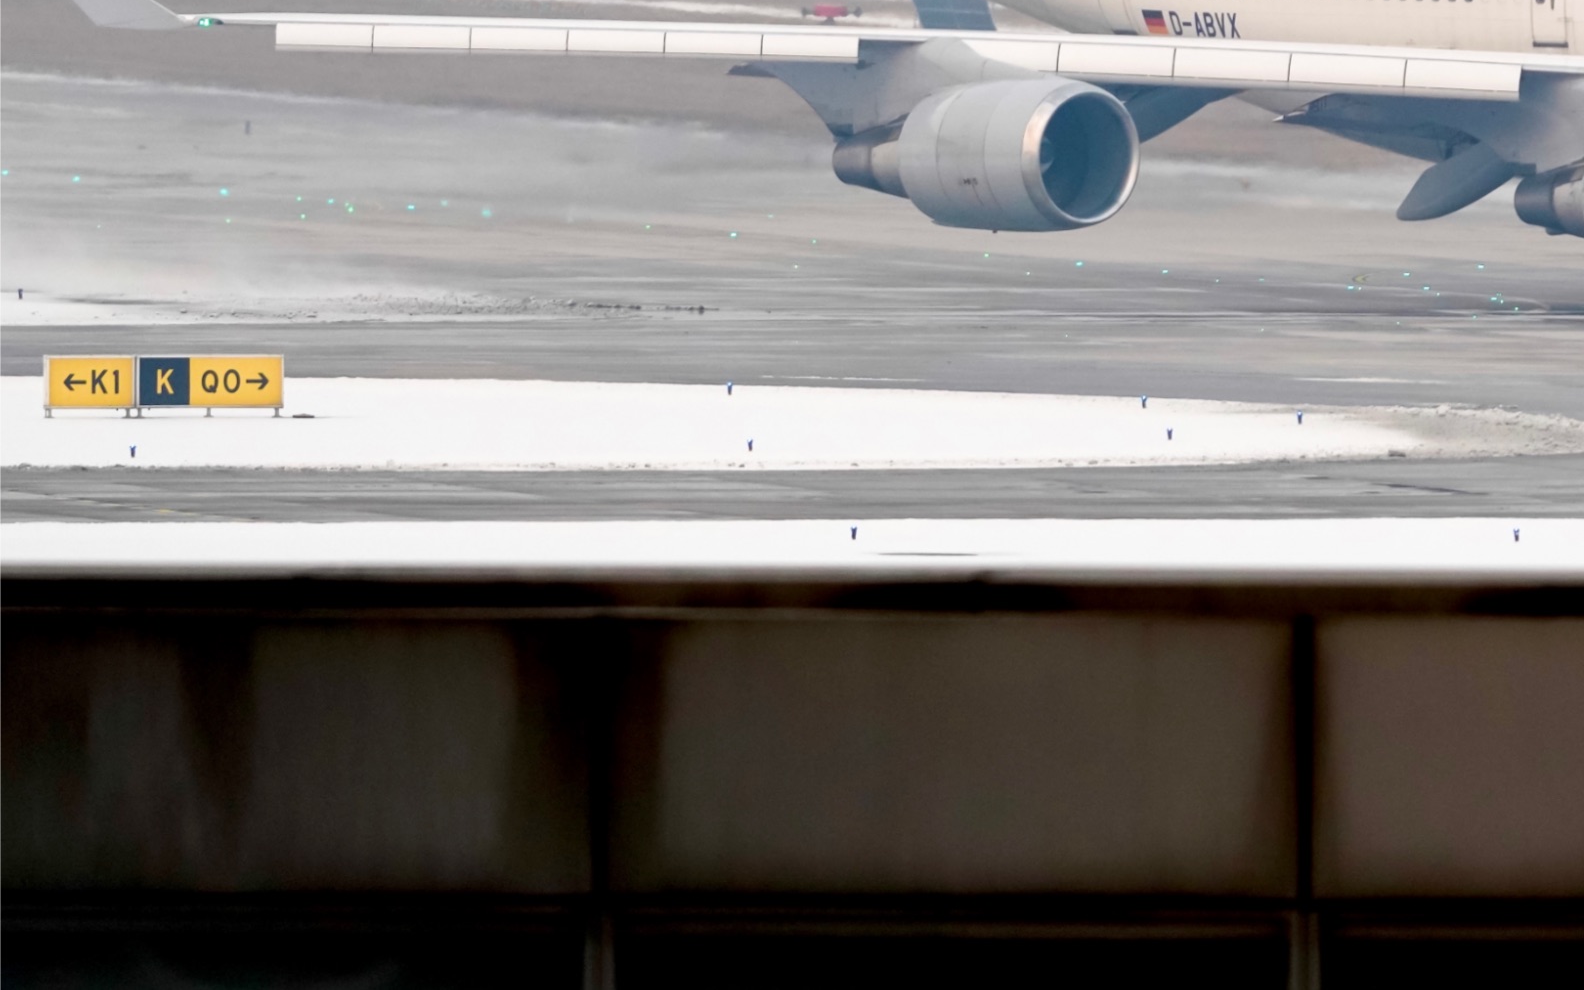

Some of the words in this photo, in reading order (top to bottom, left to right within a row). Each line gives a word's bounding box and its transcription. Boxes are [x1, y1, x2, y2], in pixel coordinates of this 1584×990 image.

[1168, 10, 1241, 39] D-ABVX
[91, 369, 120, 394] K1
[156, 368, 174, 395] K
